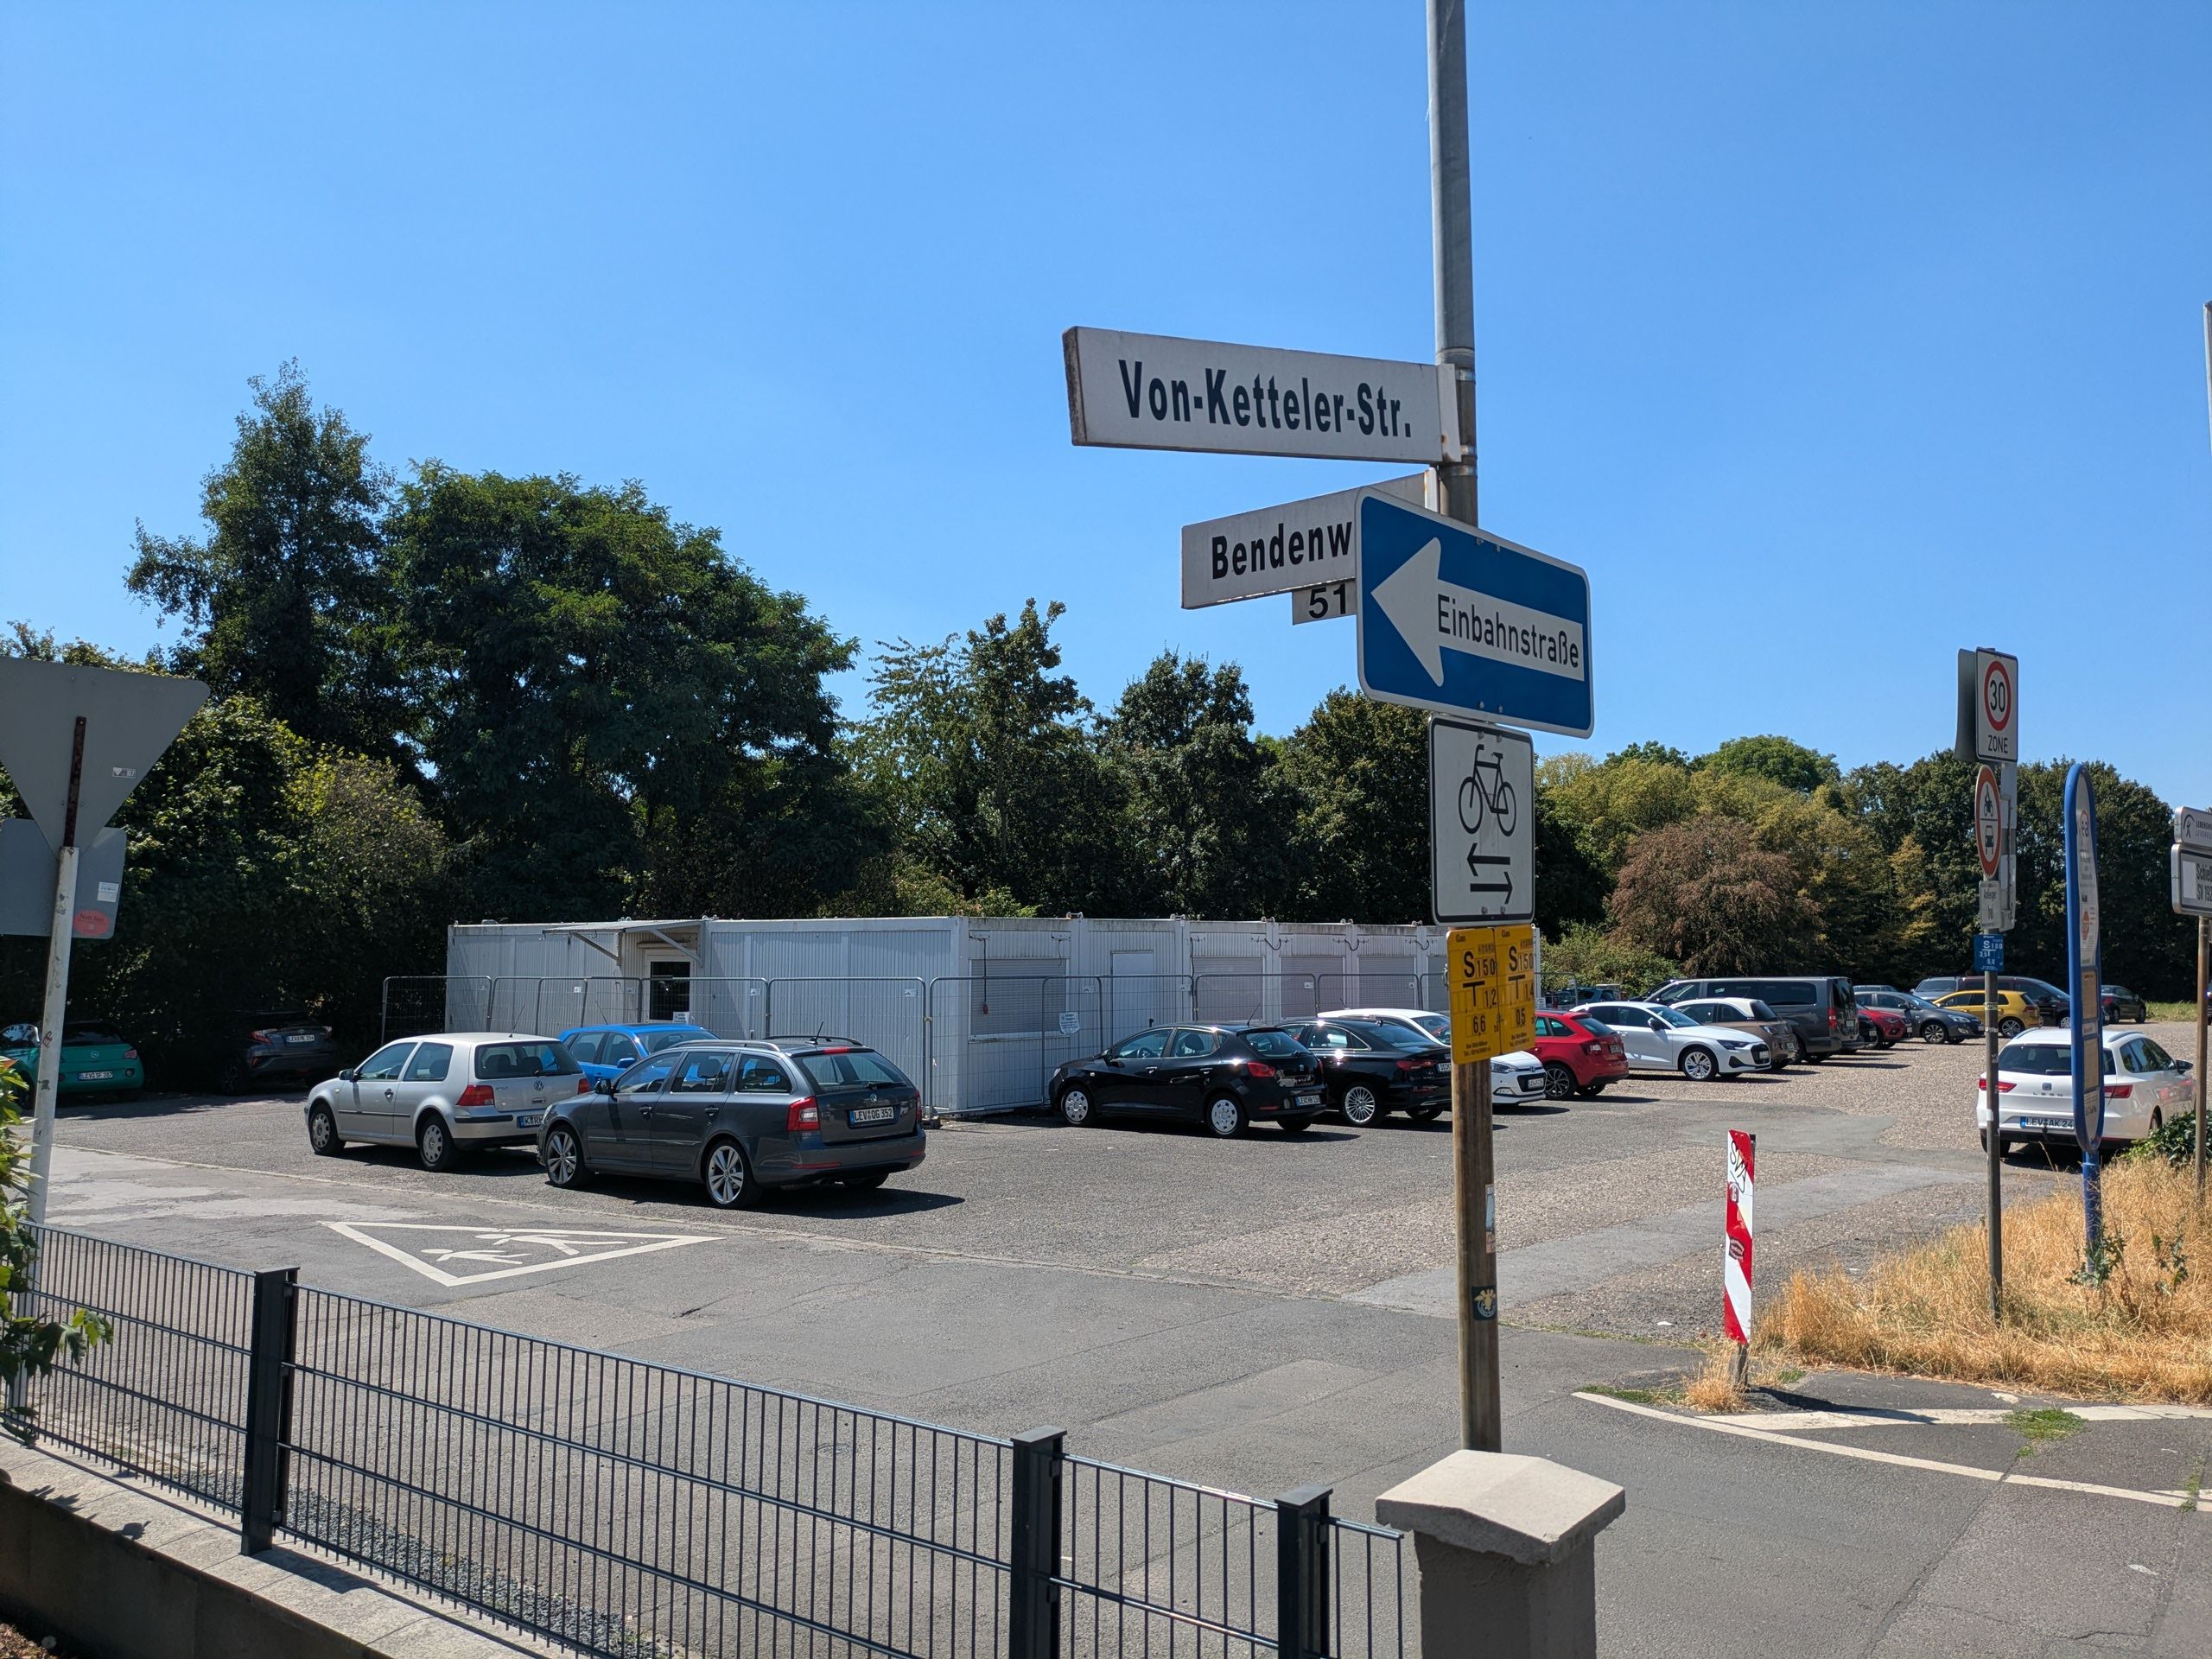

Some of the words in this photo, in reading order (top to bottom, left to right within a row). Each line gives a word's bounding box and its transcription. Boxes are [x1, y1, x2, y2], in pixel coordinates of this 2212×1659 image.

[1117, 359, 1412, 438] Von-Ketteler-Str.
[1211, 521, 1353, 581] Bendenw
[1308, 583, 1347, 620] 51
[1437, 593, 1580, 669] Einbahnstraße
[1989, 679, 2005, 713] 30
[1987, 734, 2009, 754] ZONE
[1455, 934, 1465, 943] Gas
[1501, 930, 1510, 938] Gas
[855, 1111, 868, 1121] LEV
[881, 1109, 893, 1118] 352
[2026, 1116, 2044, 1127] LEV
[2049, 1117, 2060, 1127] AK
